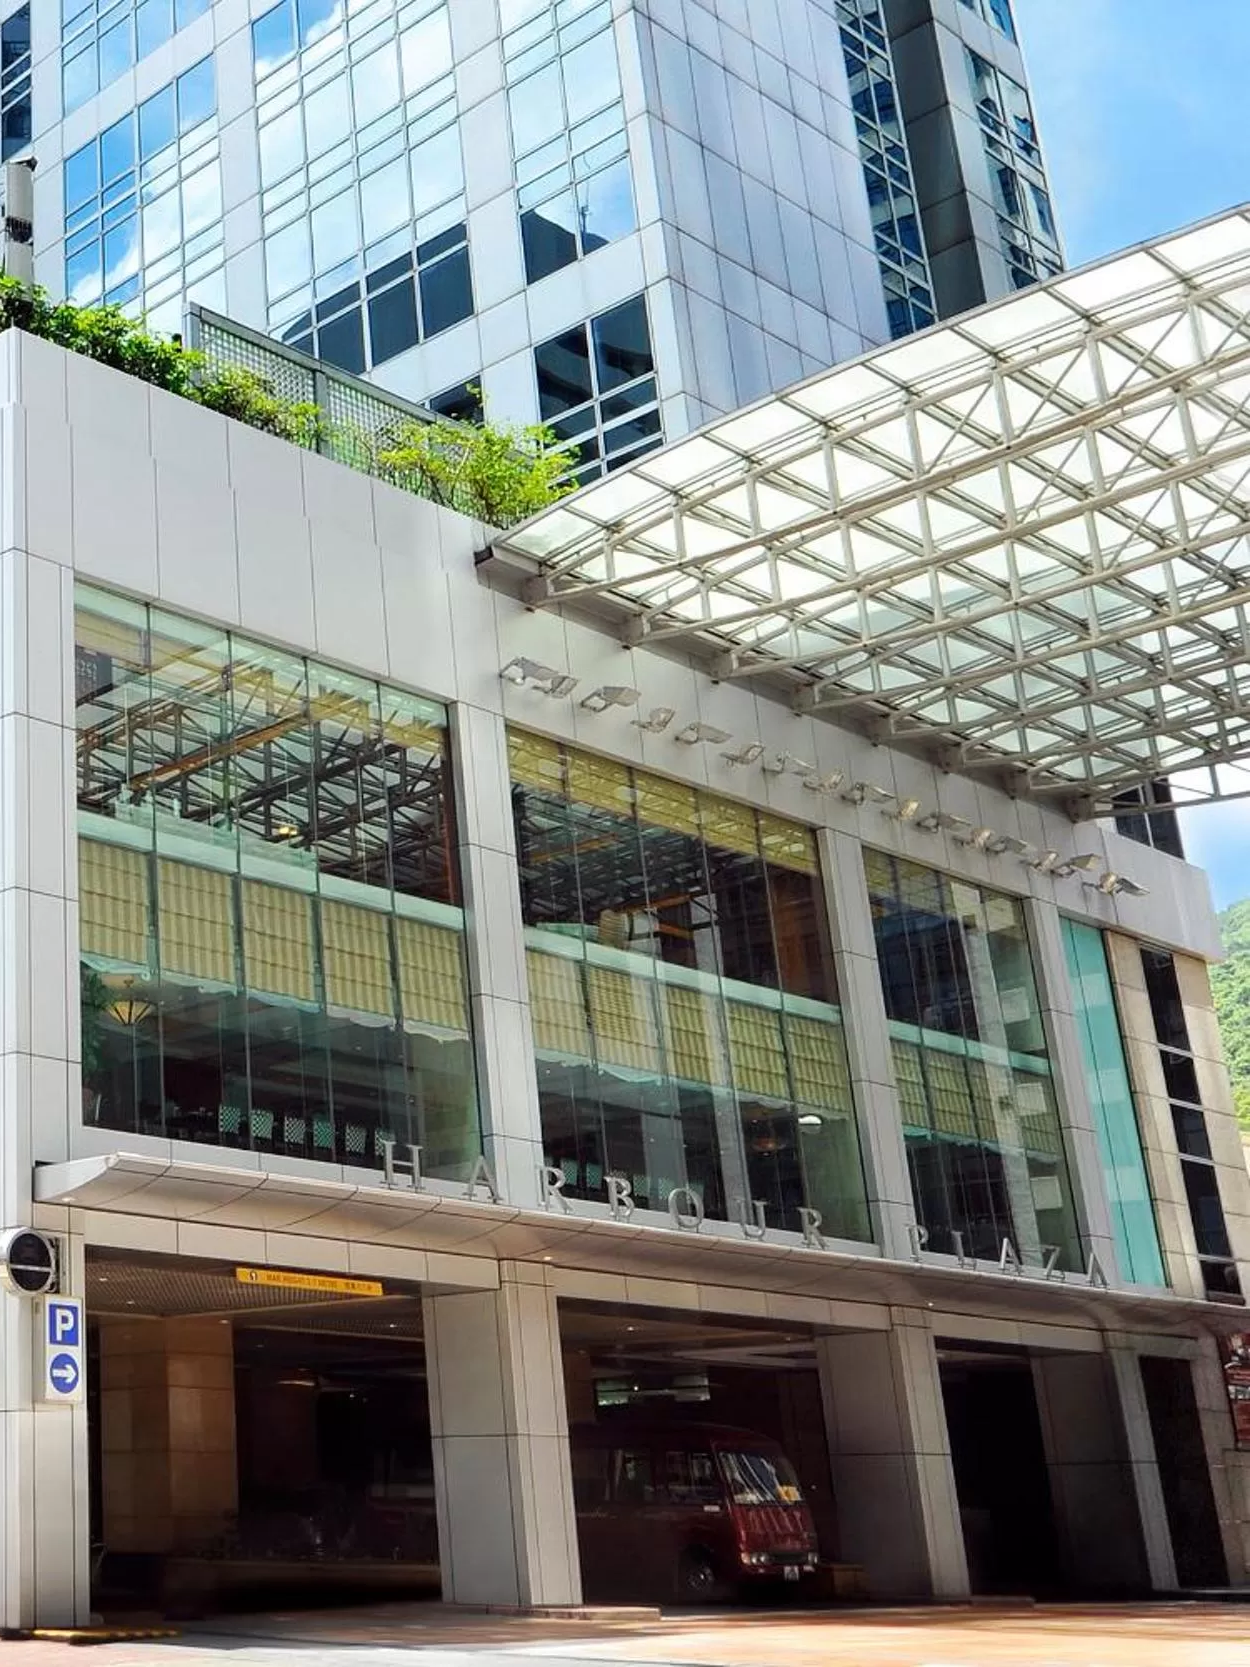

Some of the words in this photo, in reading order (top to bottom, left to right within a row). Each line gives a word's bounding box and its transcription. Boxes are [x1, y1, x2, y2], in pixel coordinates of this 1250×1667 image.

[379, 1140, 828, 1250] HARBOUR
[906, 1223, 1109, 1289] PLAZA
[55, 1307, 75, 1341] P
